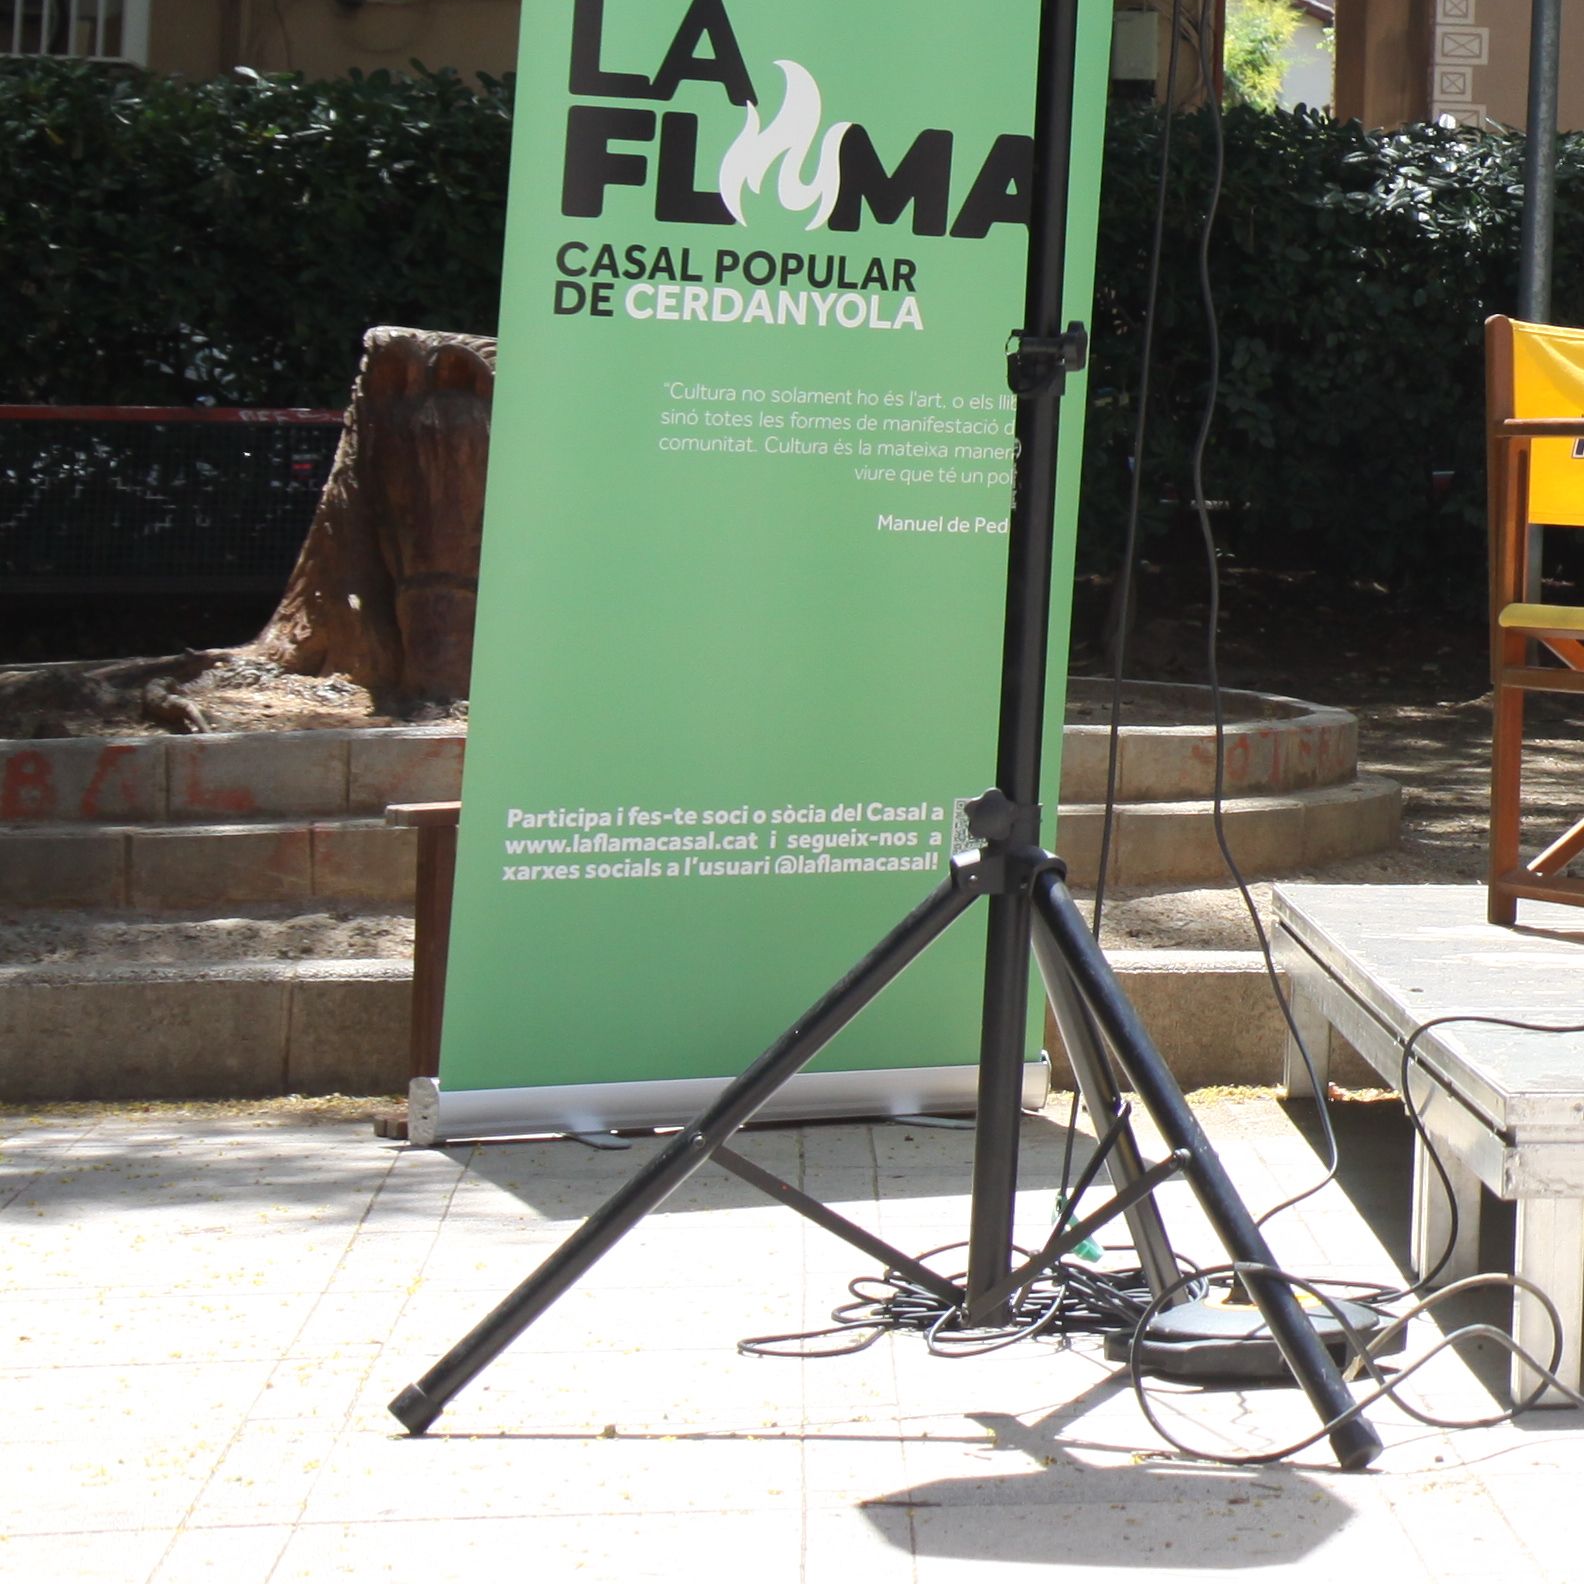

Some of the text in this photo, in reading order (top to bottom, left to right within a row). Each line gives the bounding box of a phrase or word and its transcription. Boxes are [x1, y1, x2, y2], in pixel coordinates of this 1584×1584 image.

[556, 241, 916, 292] CASAL POPULAR
[553, 280, 924, 330] DE CERDANYOLA
[742, 389, 766, 402] no
[771, 387, 852, 405] solament
[857, 390, 879, 406] ho
[884, 390, 904, 406] és
[952, 396, 964, 409] o
[969, 394, 994, 410] els
[660, 408, 699, 425] sinó
[705, 410, 753, 427] totes
[759, 411, 785, 428] les
[790, 411, 851, 430] formes
[856, 414, 878, 431] de
[883, 416, 999, 435] manifestació
[764, 436, 828, 454] Cultura
[833, 438, 853, 455] és
[858, 439, 872, 456] la
[877, 441, 948, 458] mateixa
[854, 465, 896, 481] viure
[900, 469, 934, 486] que
[938, 467, 957, 483] té
[961, 471, 983, 484] un
[877, 514, 943, 532] Manuel
[947, 517, 970, 533] de
[507, 802, 945, 832] Participa i fes-te soci o sòcia del Casal a
[505, 828, 943, 854] www.laflamacasal.cat i segueix-nos a
[502, 864, 580, 881] xarxes
[585, 858, 661, 878] socials
[667, 862, 679, 877] a
[775, 851, 939, 875] @laflamacasal!
